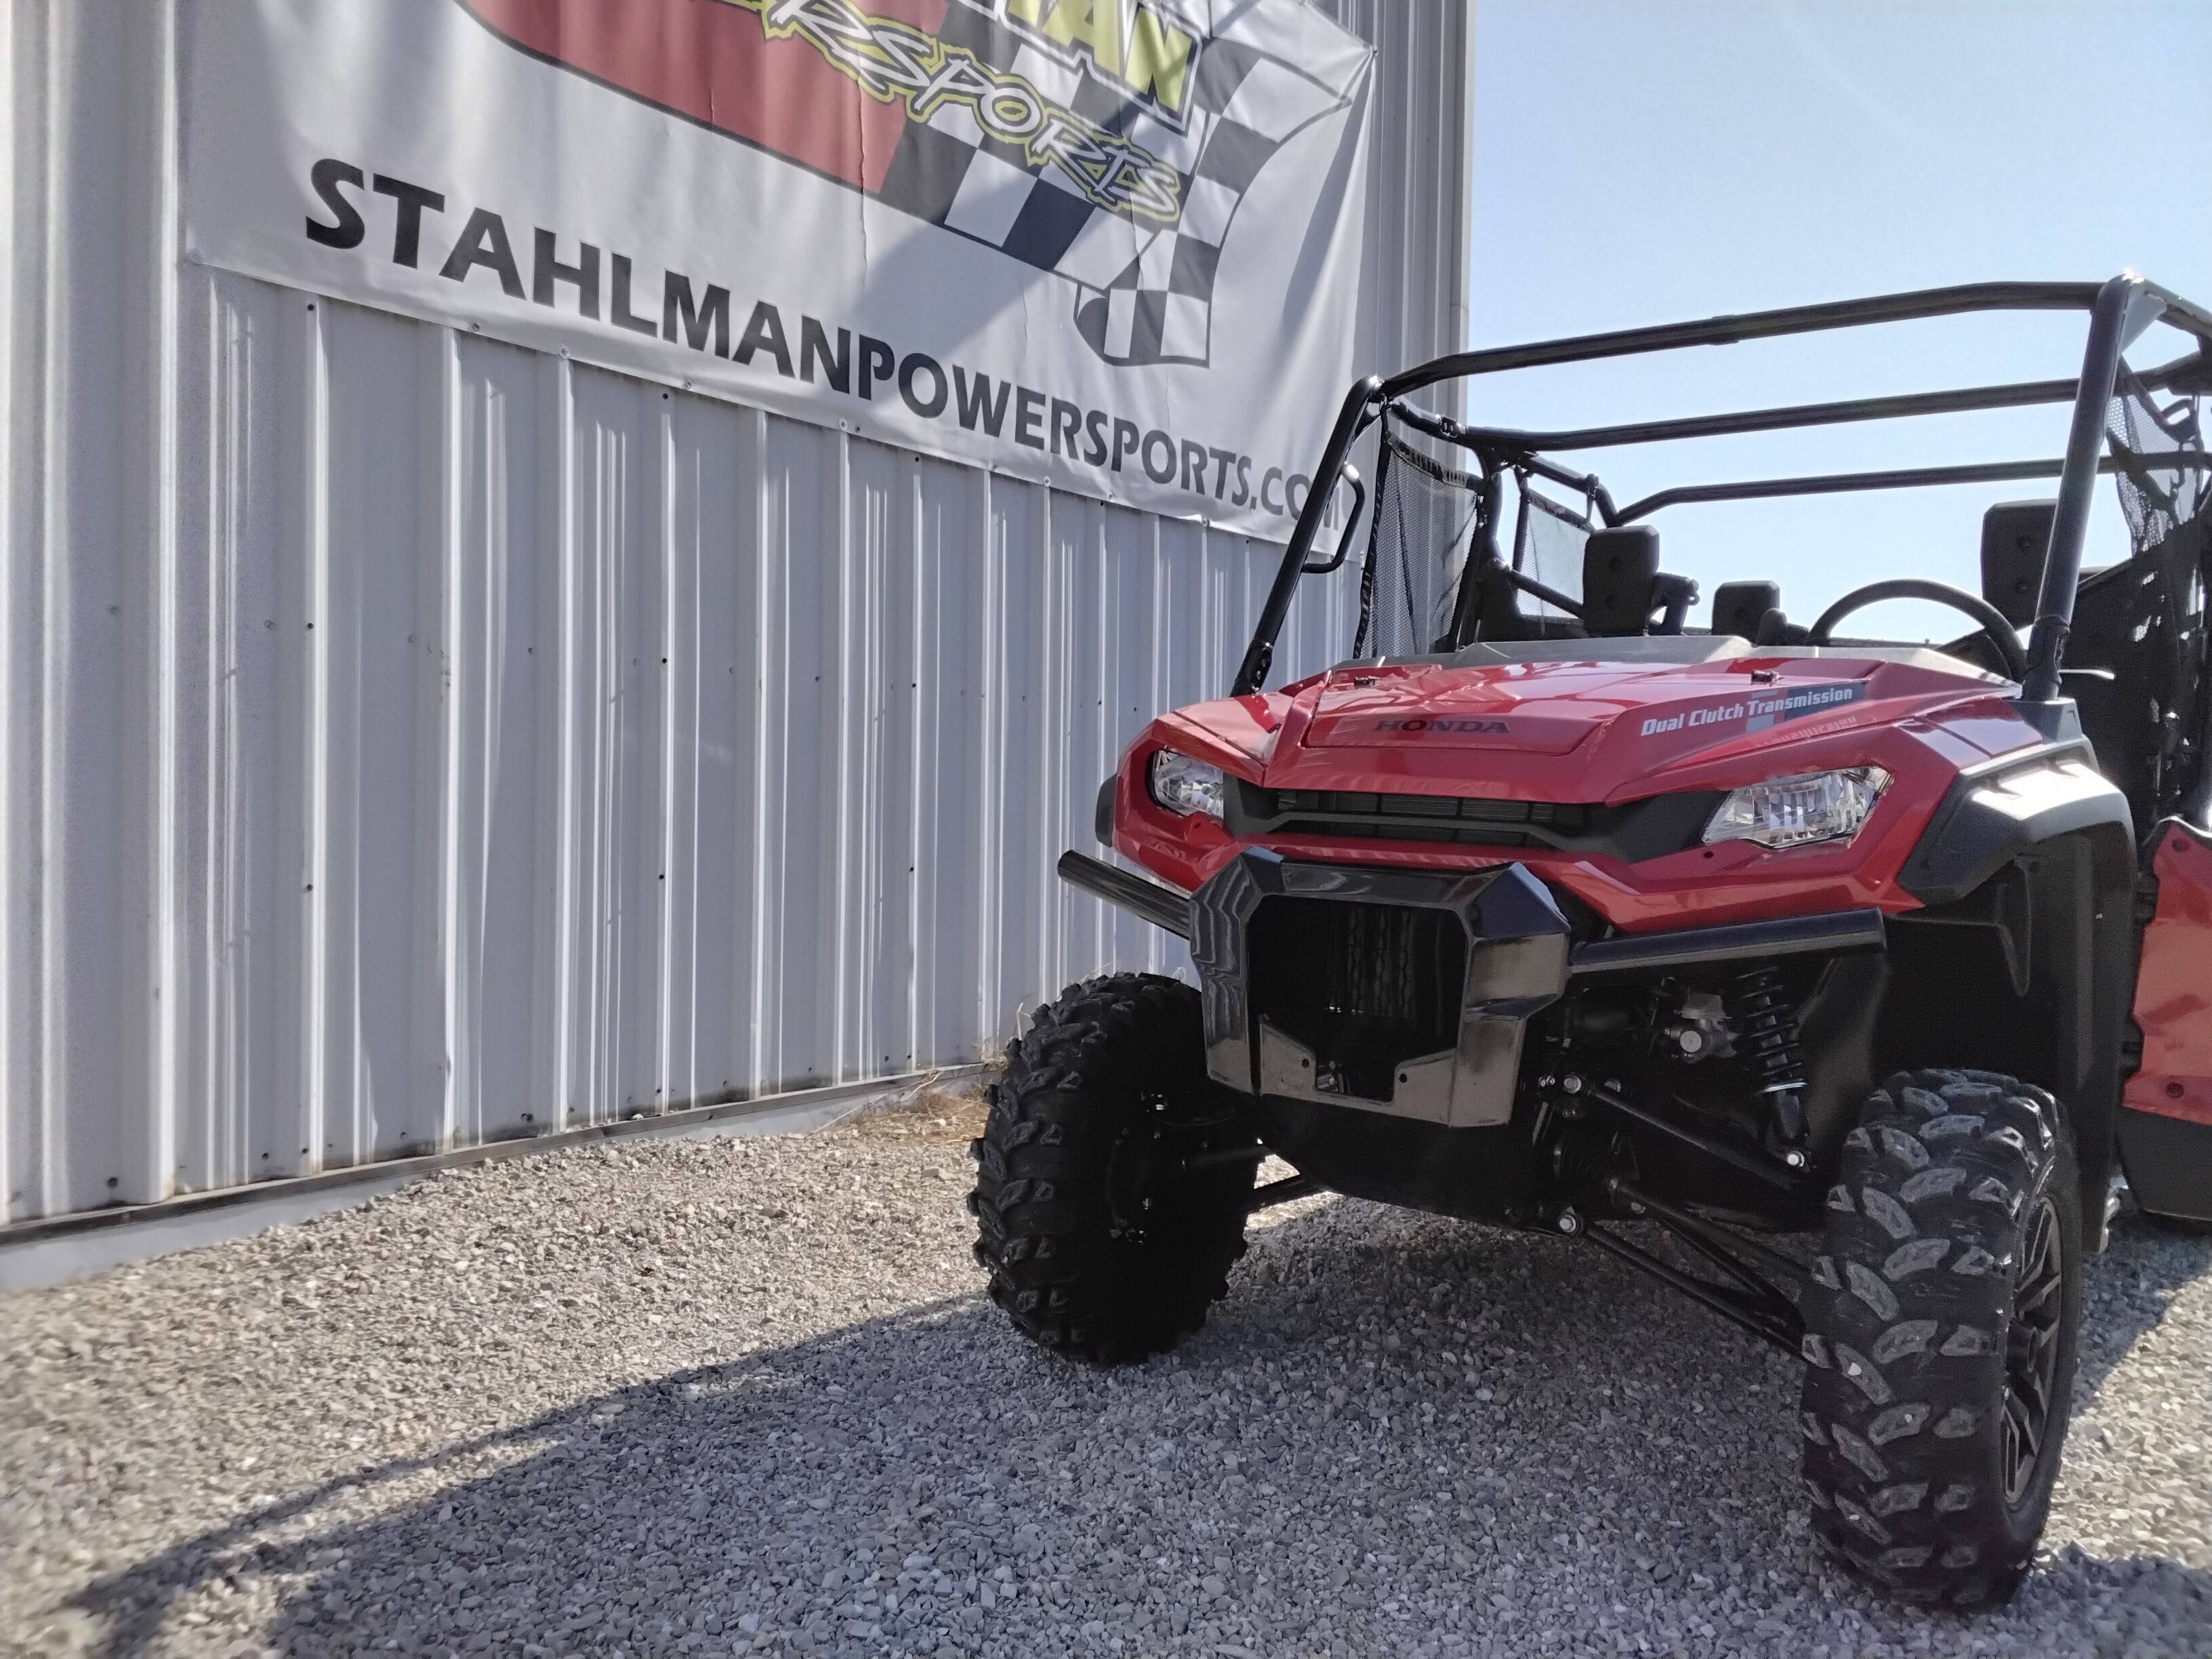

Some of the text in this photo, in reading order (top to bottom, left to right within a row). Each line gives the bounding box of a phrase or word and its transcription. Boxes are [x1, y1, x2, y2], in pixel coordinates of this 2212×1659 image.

[1373, 719, 1510, 733] HONDA
[1641, 689, 1853, 736] Dual Clutch Transmission
